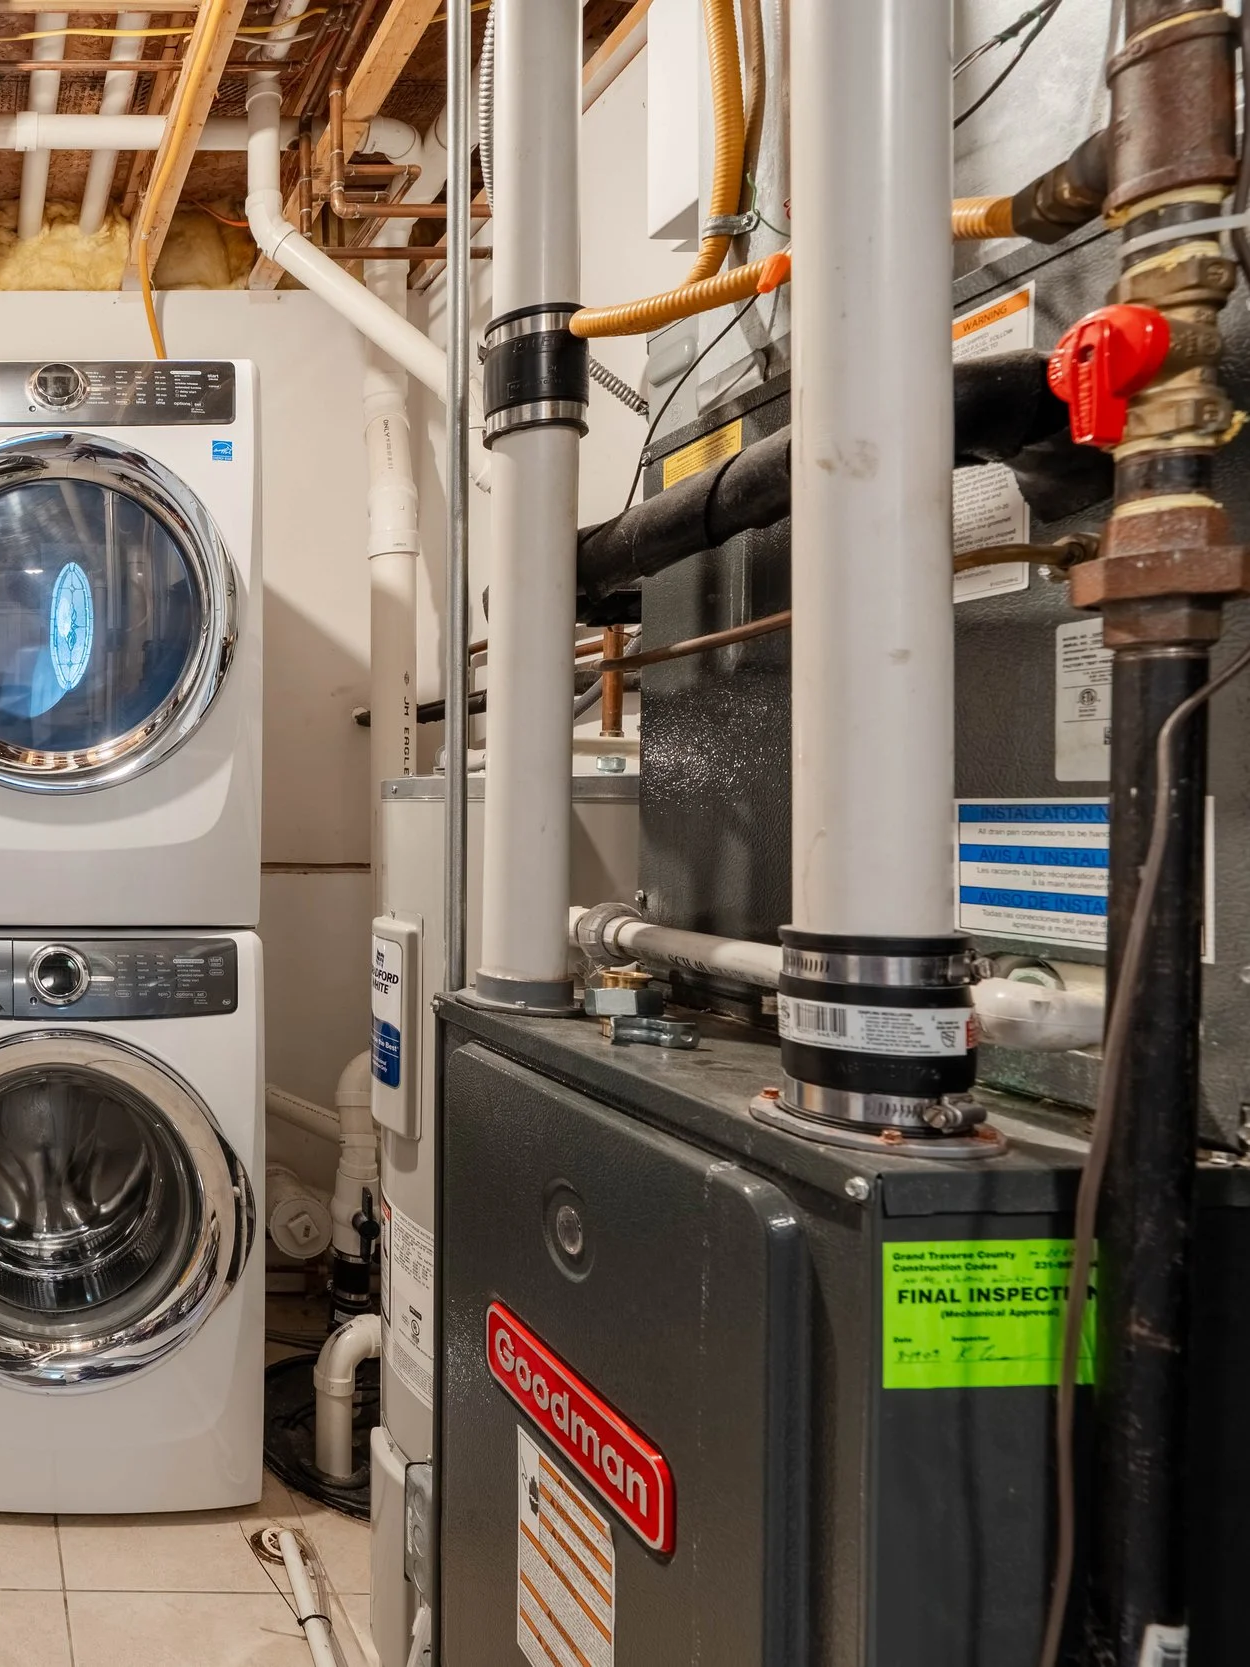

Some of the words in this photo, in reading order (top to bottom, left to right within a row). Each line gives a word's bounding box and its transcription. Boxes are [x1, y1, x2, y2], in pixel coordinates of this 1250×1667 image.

[962, 305, 1007, 332] WARNING
[403, 696, 410, 717] JM
[981, 806, 1094, 821] INSTALLATION
[980, 848, 1012, 862] AVIS
[978, 890, 1024, 906] AVISO
[1028, 895, 1049, 908] DE
[892, 1251, 925, 1261] Grand
[928, 1251, 974, 1260] Traverse
[977, 1250, 1016, 1261] County
[892, 1262, 962, 1273] Construction
[964, 1261, 998, 1272] Codes
[897, 1288, 962, 1305] FINAL
[968, 1285, 1098, 1304] INSPECTIN
[494, 1327, 648, 1519] Goodman
